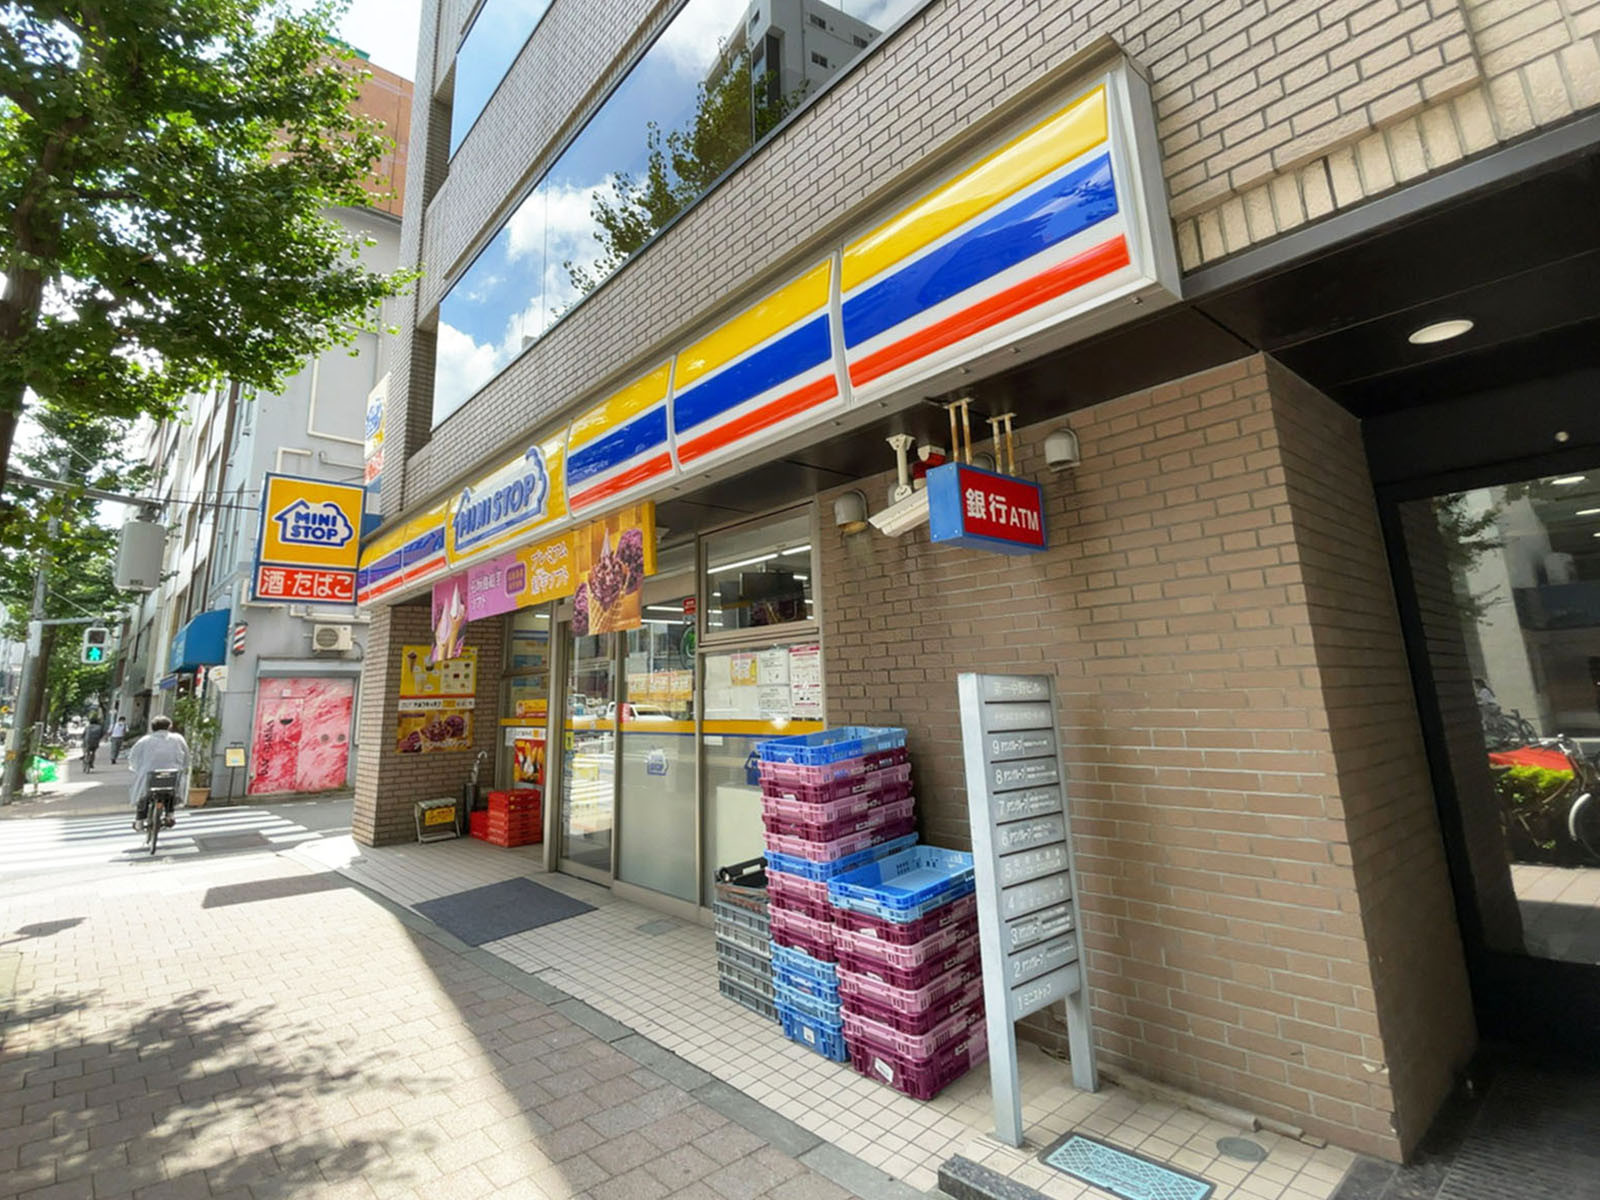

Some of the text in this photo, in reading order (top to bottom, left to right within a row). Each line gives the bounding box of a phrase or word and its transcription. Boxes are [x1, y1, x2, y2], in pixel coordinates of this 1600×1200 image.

[458, 472, 536, 539] MINI STOP
[965, 488, 1040, 532] 銀行ATM
[294, 511, 338, 527] MINI
[290, 525, 338, 540] STOP
[992, 740, 1000, 755] 9
[995, 768, 1004, 785] 8
[998, 799, 1005, 816] 7
[1001, 831, 1010, 848] 6
[1007, 895, 1015, 909] 4
[1010, 927, 1018, 945] 3
[1013, 960, 1022, 978] 2
